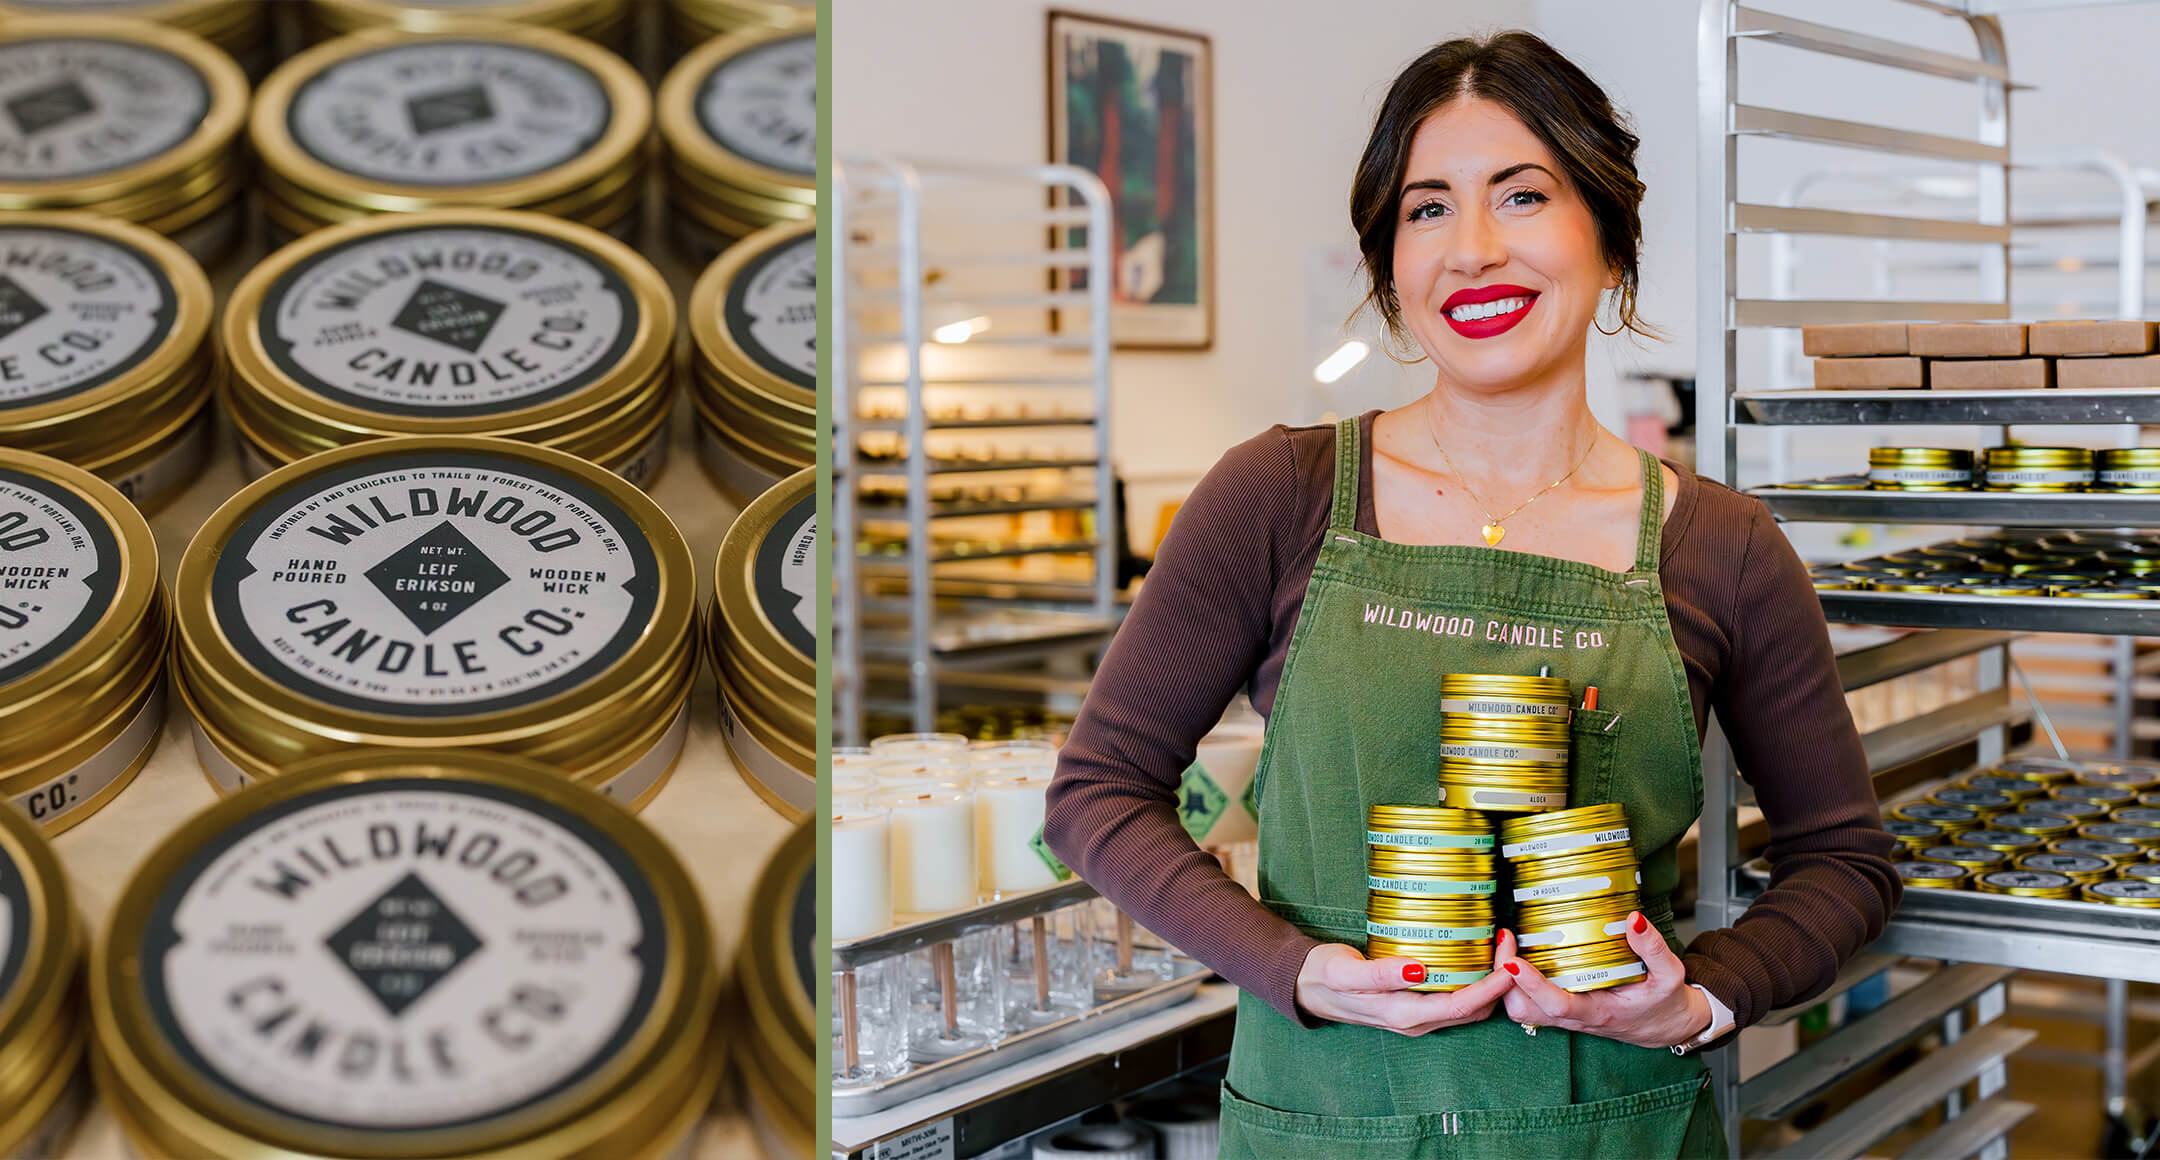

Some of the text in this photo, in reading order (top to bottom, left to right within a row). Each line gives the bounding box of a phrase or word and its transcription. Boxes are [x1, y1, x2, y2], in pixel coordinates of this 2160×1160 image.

[347, 348, 541, 387] CANDLE
[269, 510, 307, 540] INSPIRED
[306, 500, 321, 512] BY
[323, 490, 345, 503] AND
[346, 474, 406, 494] DEDICATED
[432, 472, 471, 480] TRAILS
[493, 476, 534, 492] FOREST
[536, 488, 563, 506] PARK,
[565, 503, 606, 538] PORTLAND,
[603, 537, 619, 555] ORE.
[306, 487, 582, 553] WILDWOOD
[420, 546, 467, 556] NET WT.
[791, 535, 814, 567] INSPIRED
[288, 559, 337, 571] HAND
[418, 563, 458, 576] LEIF
[272, 571, 347, 584] POURED
[530, 568, 606, 583] WOODEN
[4, 579, 51, 590] WICK
[395, 579, 476, 594] ERIKSON
[543, 582, 589, 595] WICK
[419, 602, 428, 611] 4
[1363, 603, 1610, 649] WILDWOOD CANDLE CO.
[286, 599, 487, 677] CANDLE
[1468, 703, 1512, 713] WILDWOOD
[1516, 705, 1545, 715] CANDLE
[1468, 747, 1499, 758] CANDLE
[1385, 835, 1414, 845] CANDLE
[1595, 830, 1626, 843] WILDWOOD
[1520, 841, 1547, 852] WILDWOOD
[252, 821, 570, 908] WILDWOOD
[1382, 879, 1408, 890] CANDLE
[1532, 886, 1560, 897] 20 HOURS
[1402, 928, 1433, 938] CANDLE
[1576, 971, 1609, 983] WILDWOOD
